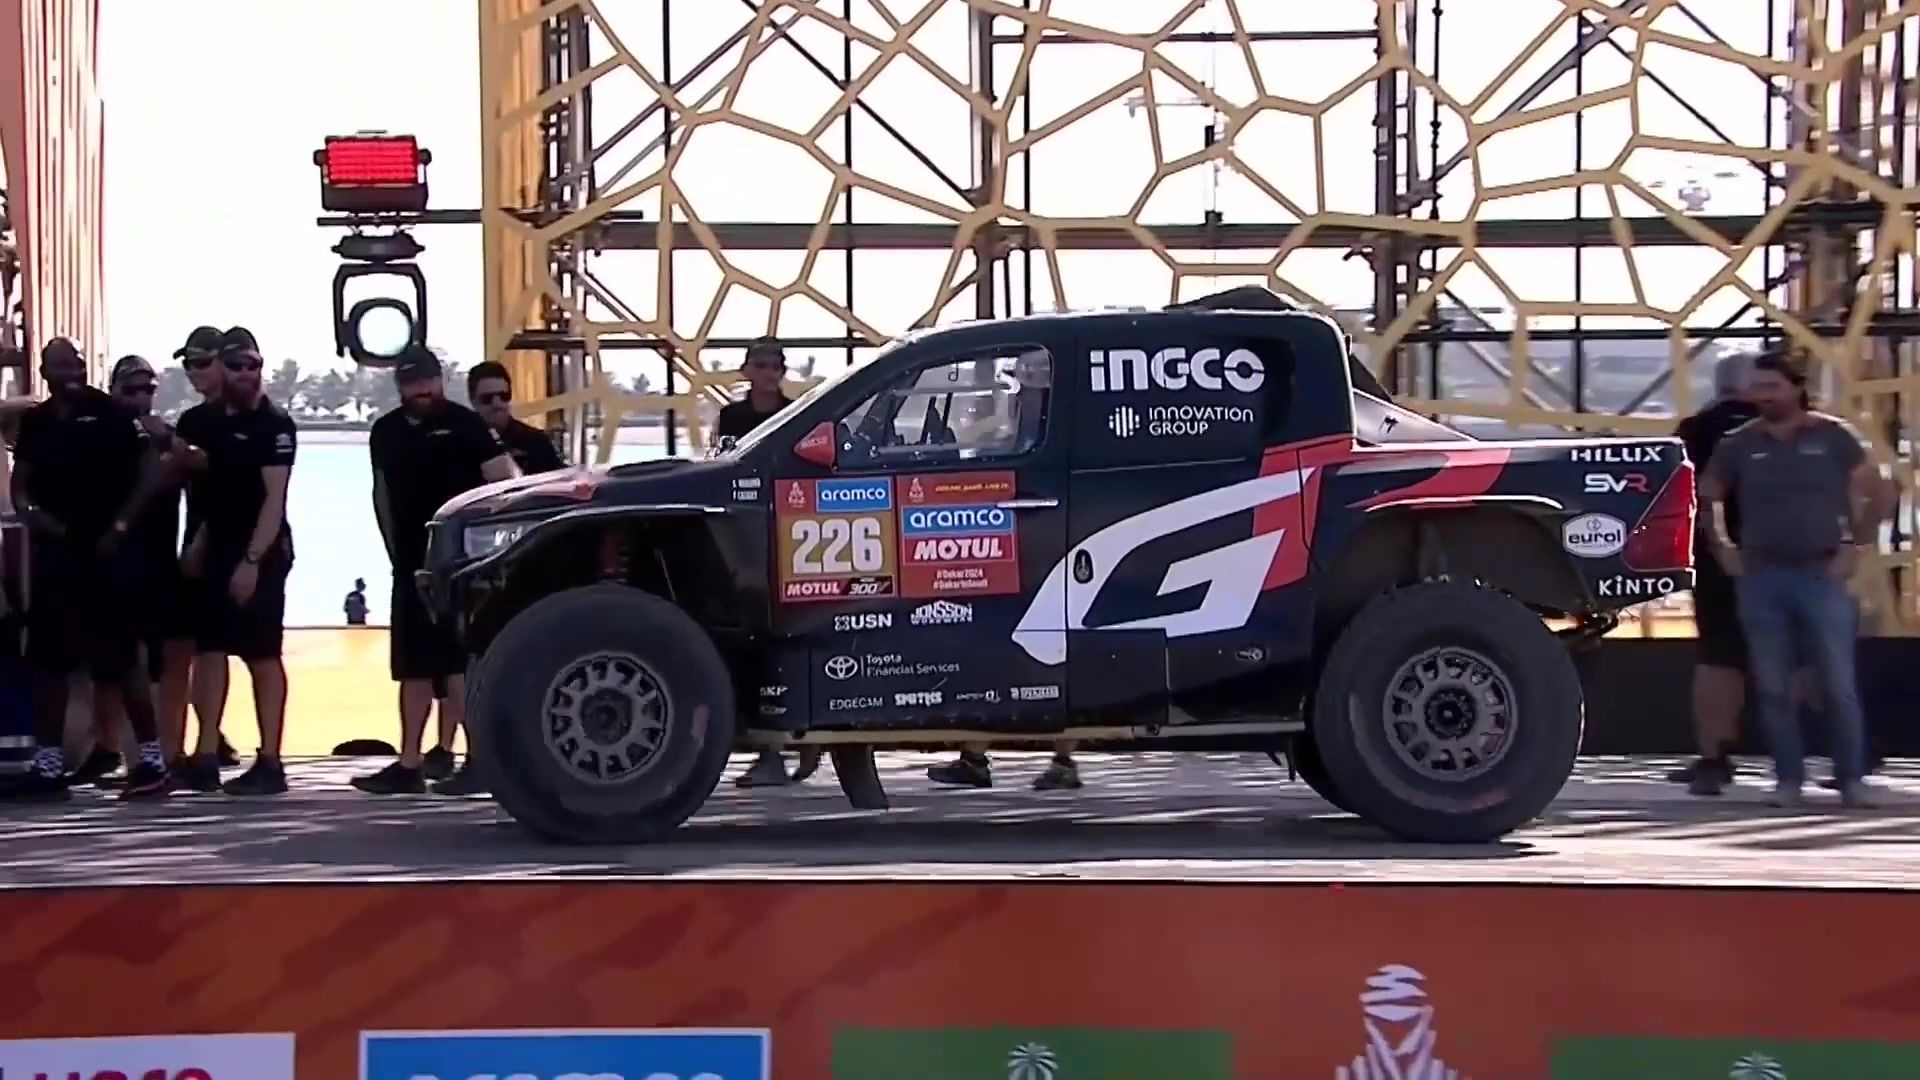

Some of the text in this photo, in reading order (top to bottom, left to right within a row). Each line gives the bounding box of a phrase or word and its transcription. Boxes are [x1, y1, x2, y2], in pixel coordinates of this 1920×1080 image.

[1149, 405, 1254, 423] INNOVATION
[1149, 421, 1209, 436] GROUP
[1571, 446, 1664, 463] HILUX
[821, 486, 886, 501] aramco
[909, 508, 1005, 529] aramco
[1568, 529, 1622, 545] eurol
[792, 517, 884, 574] 226
[913, 537, 1004, 561] MOTUL
[786, 581, 841, 596] MOTUL
[850, 613, 893, 630] USN
[866, 653, 902, 665] Toyota
[866, 664, 915, 678] Financial
[829, 697, 884, 711] EDGECAM
